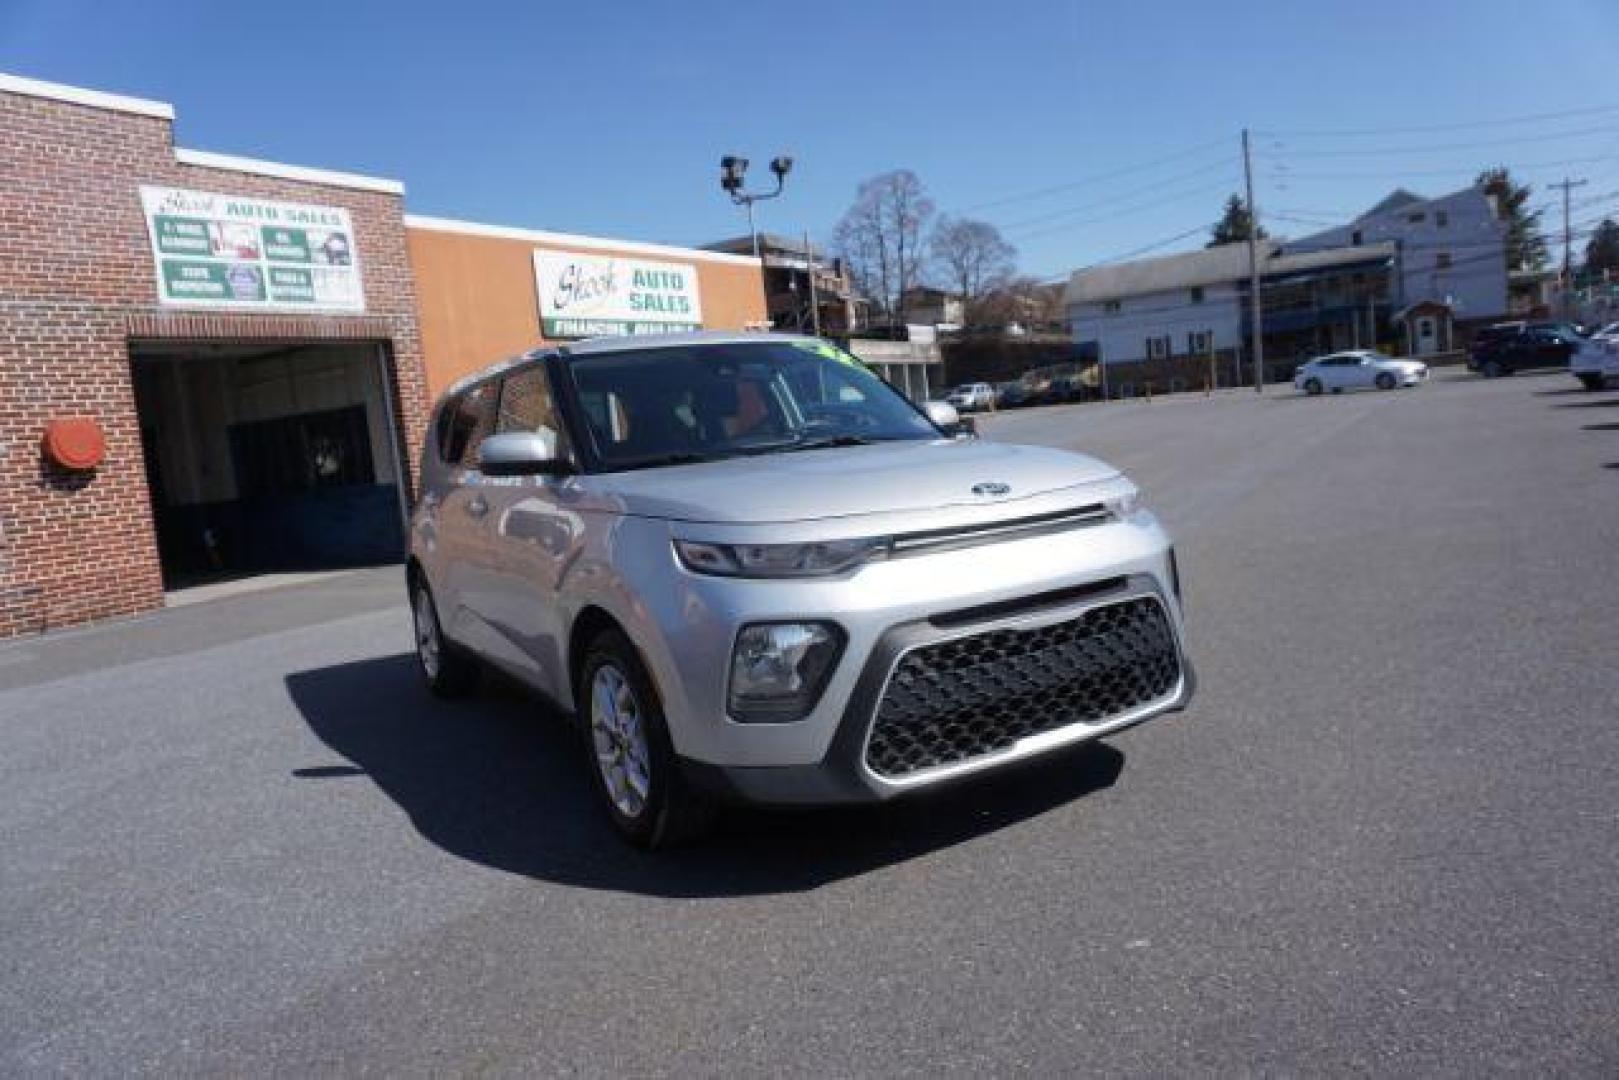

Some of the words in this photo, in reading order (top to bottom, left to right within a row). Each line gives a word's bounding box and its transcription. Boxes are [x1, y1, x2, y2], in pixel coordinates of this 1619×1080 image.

[226, 200, 279, 219] AUTO
[286, 209, 342, 224] SALES
[632, 267, 685, 290] AUTO
[629, 293, 690, 313] SALES
